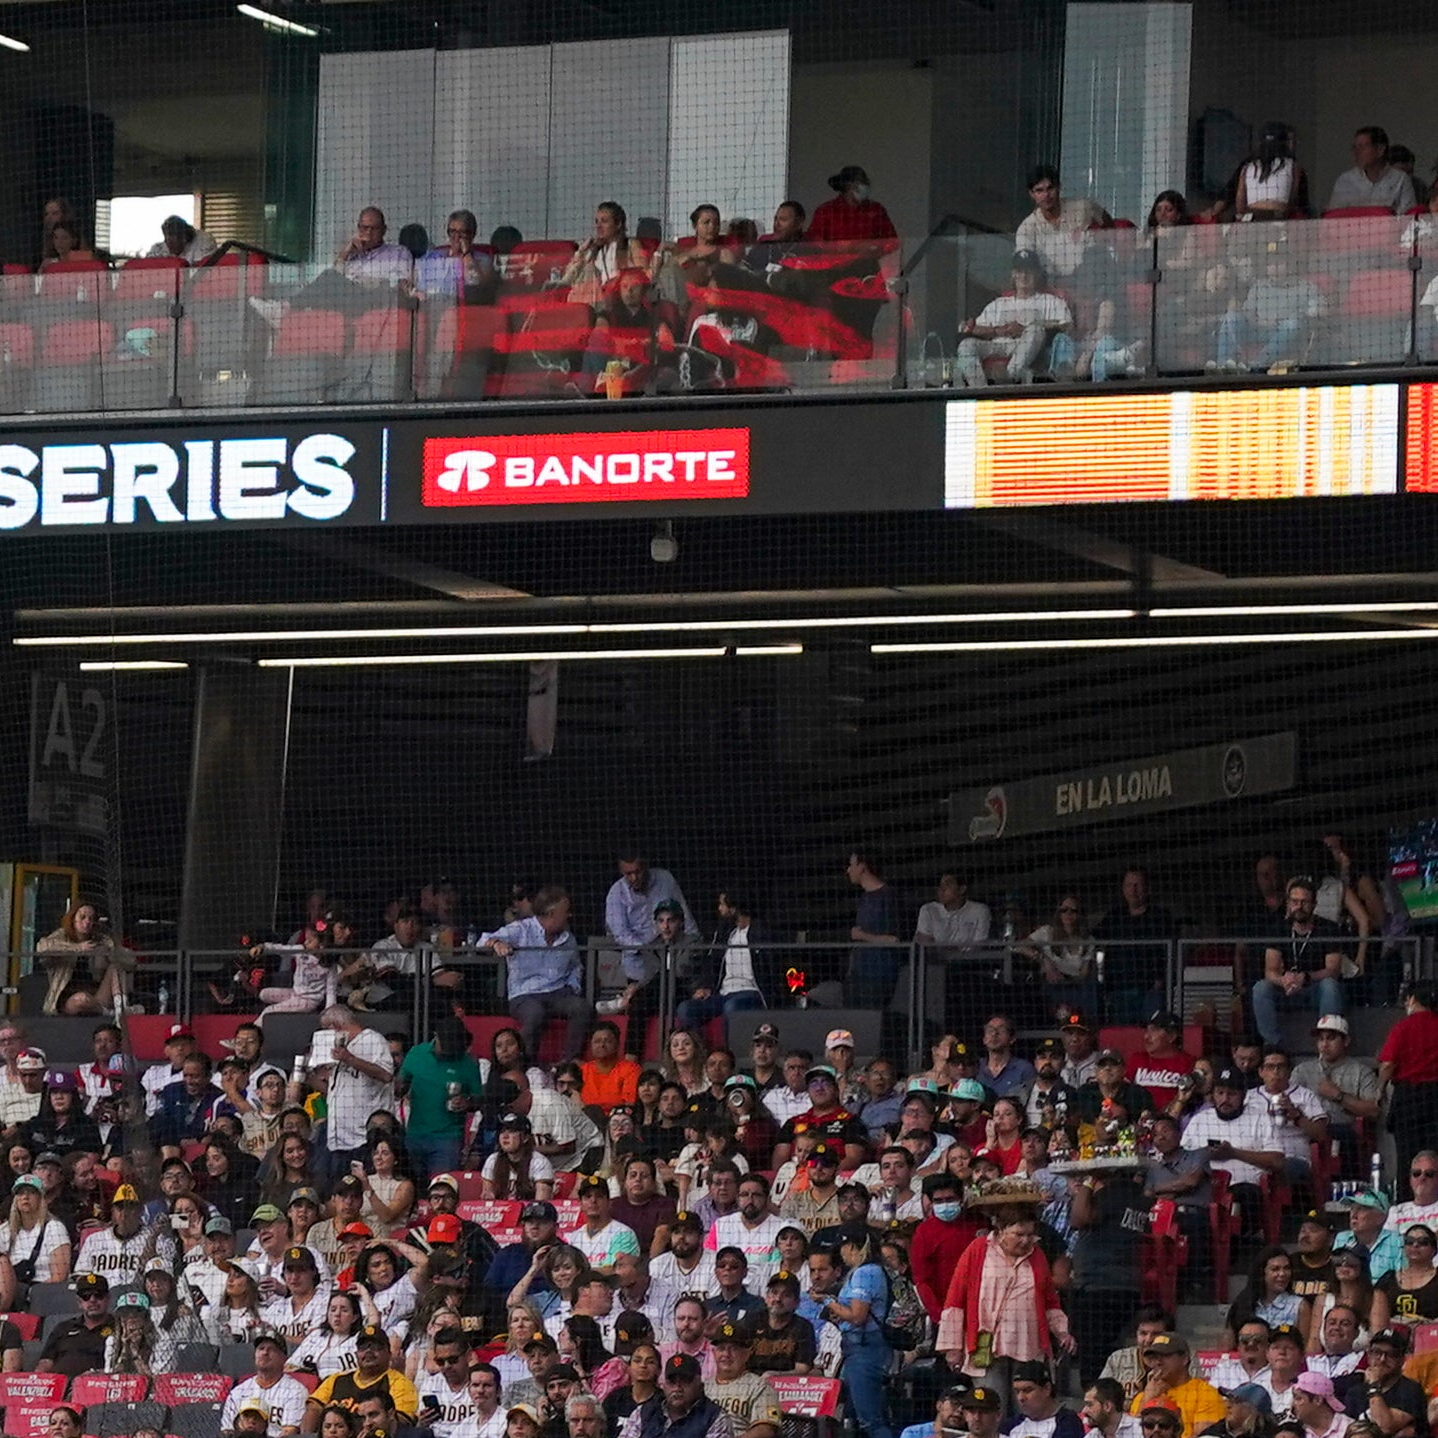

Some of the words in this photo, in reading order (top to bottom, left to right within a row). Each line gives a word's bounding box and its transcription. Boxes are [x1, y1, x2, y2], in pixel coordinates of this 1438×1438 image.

[506, 451, 736, 488] BANORTE
[43, 681, 105, 778] A2
[1055, 781, 1082, 816] EN
[1086, 775, 1114, 810] LA
[1115, 765, 1173, 806] LOMA
